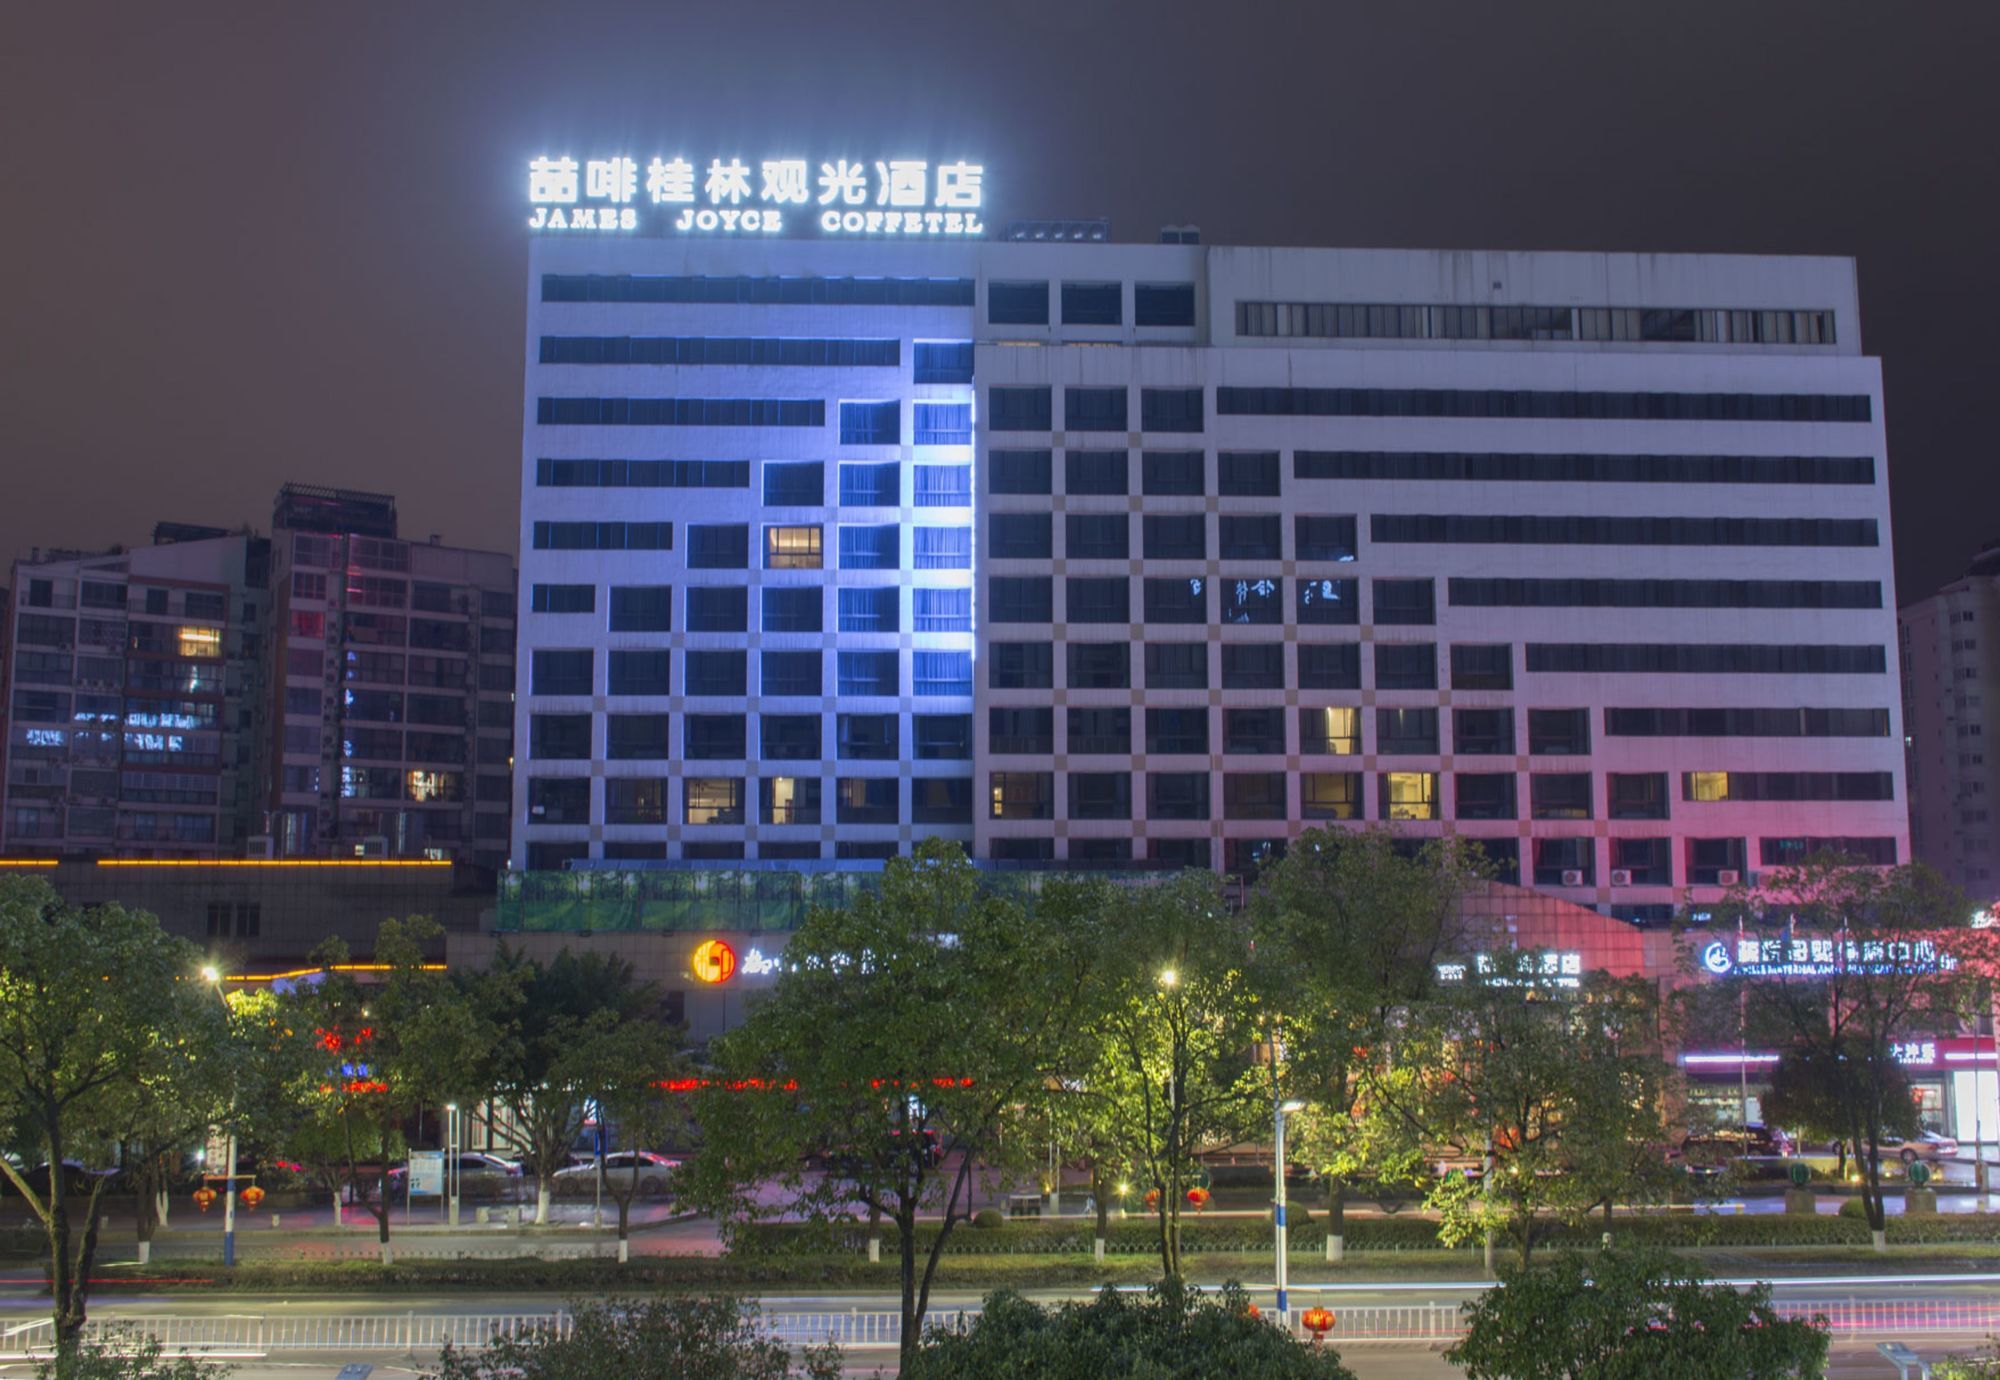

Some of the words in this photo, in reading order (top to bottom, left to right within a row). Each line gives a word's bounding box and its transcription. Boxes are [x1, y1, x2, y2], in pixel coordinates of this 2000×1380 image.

[530, 157, 984, 207] 喆啡桂林观光酒店
[530, 208, 638, 230] JAMES
[677, 210, 782, 232] JOYCE
[821, 211, 984, 233] COFFETEL
